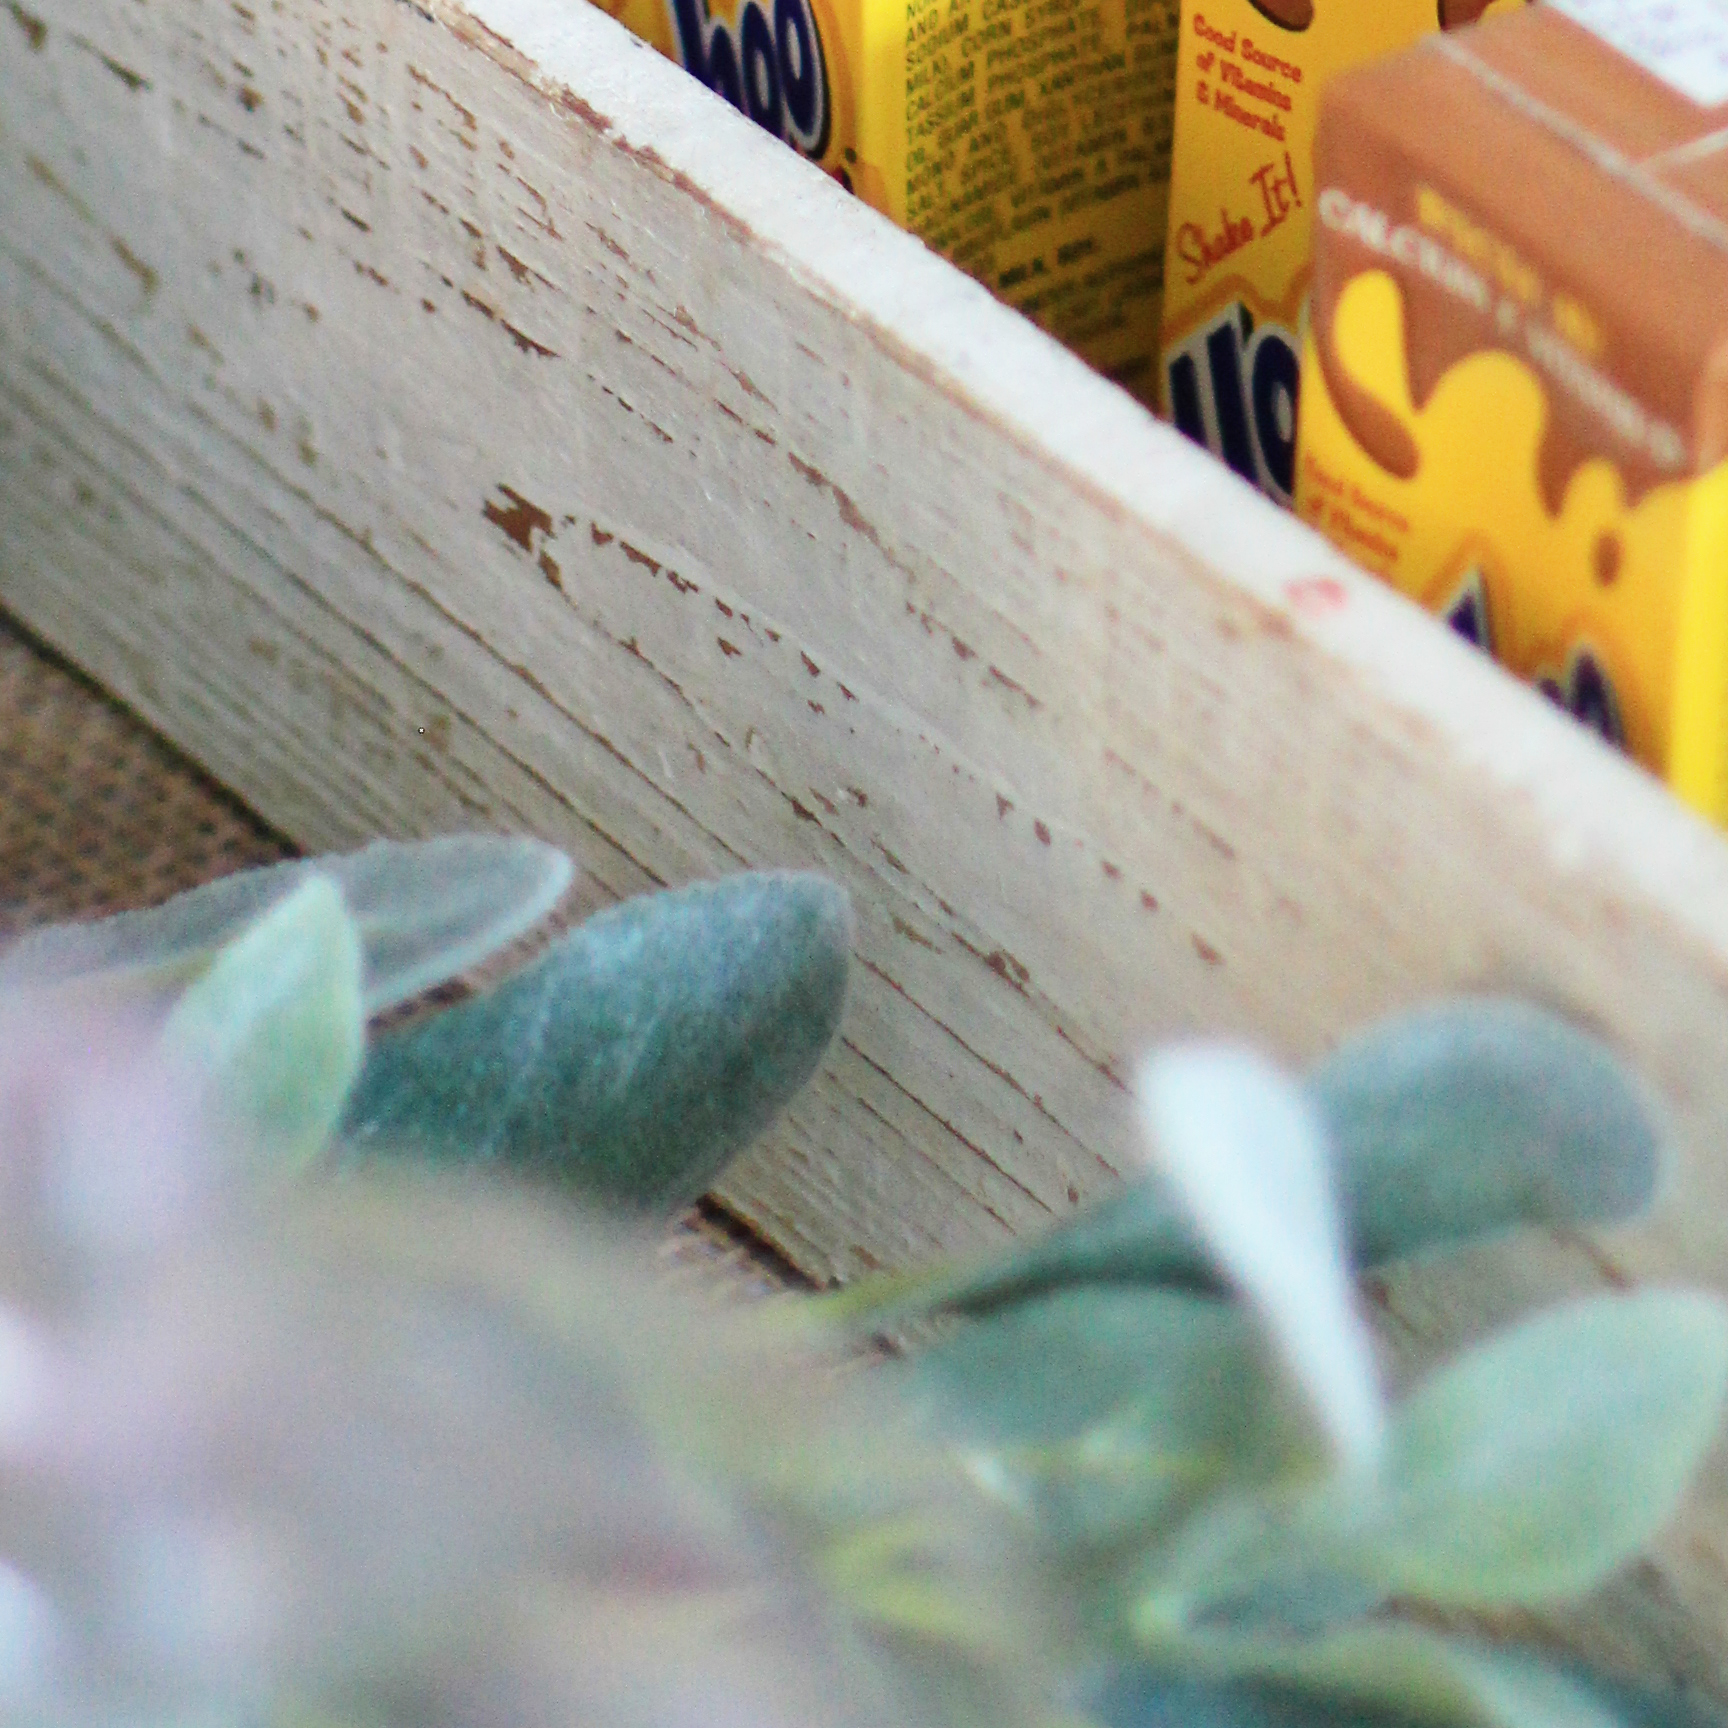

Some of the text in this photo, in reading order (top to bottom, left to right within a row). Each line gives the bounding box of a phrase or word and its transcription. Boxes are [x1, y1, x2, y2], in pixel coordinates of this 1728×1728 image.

[1193, 12, 1303, 85] Good Source
[1196, 51, 1293, 113] of Vitamins
[1213, 89, 1286, 143] Minerals
[1174, 206, 1255, 286] Shake
[1248, 150, 1303, 238] It!
